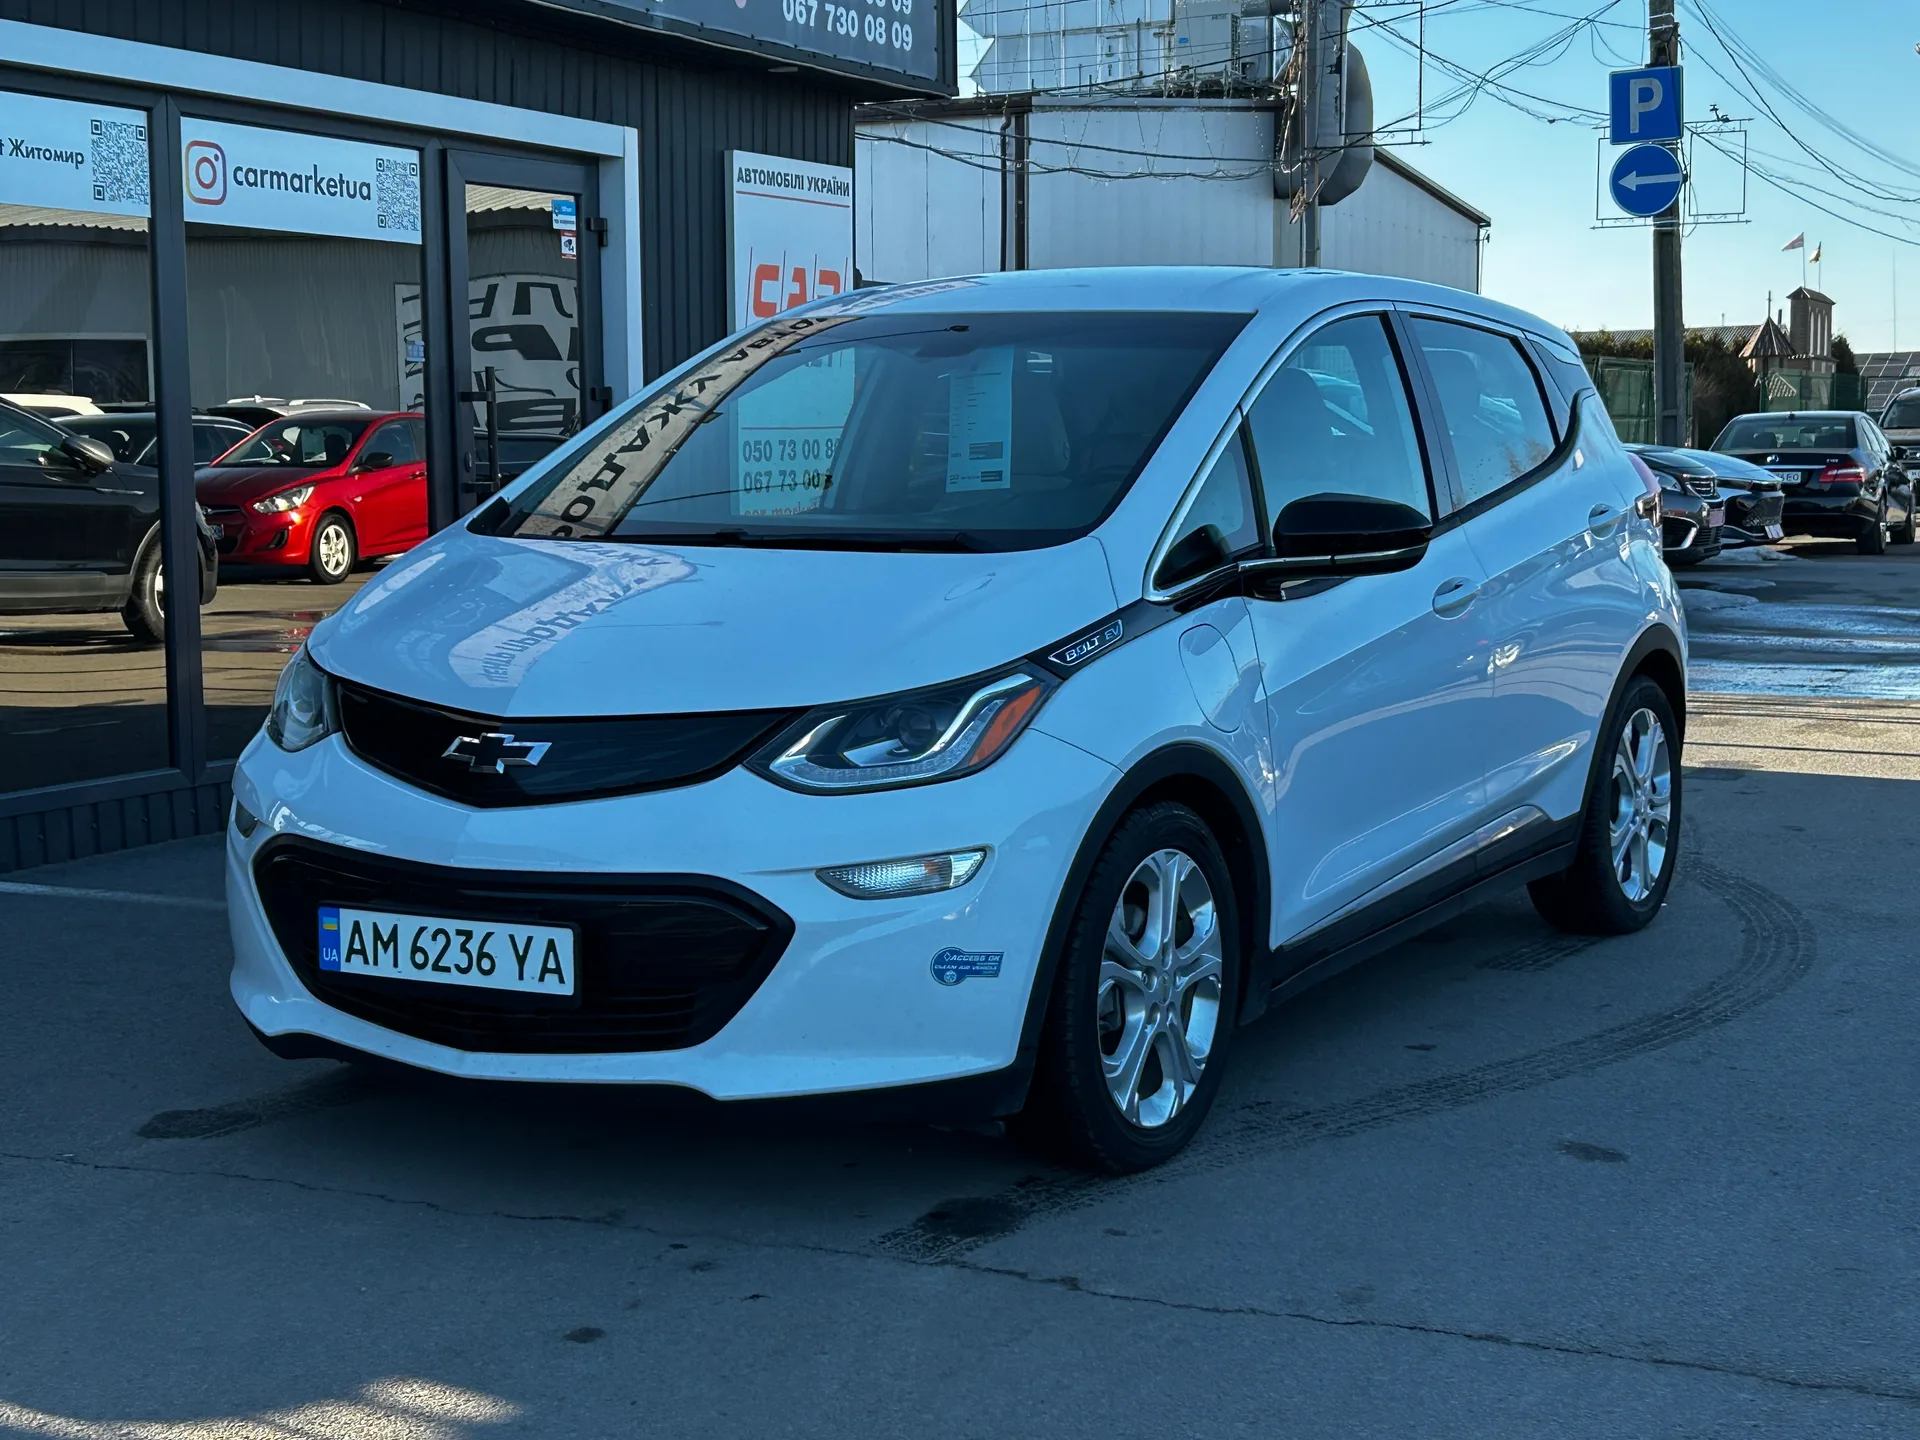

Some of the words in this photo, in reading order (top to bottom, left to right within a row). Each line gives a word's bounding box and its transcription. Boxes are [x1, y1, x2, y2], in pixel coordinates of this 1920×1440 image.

[783, 0, 818, 27] 067
[825, 3, 859, 38] 730
[864, 13, 887, 45] 08
[892, 21, 913, 51] 09
[1629, 78, 1663, 134] P
[8, 137, 85, 170] Житомир
[233, 163, 372, 201] carmarketua
[737, 166, 804, 191] АВТОМОБІЛІ
[807, 175, 850, 197] УКРАЇНИ
[742, 439, 773, 463] 050
[778, 438, 797, 462] 73
[802, 438, 820, 461] 00
[743, 470, 773, 494] 067
[778, 469, 797, 492] 73
[1064, 634, 1100, 662] BOLT
[1104, 625, 1119, 641] EV
[322, 947, 339, 963] UA
[345, 919, 399, 969] AM
[410, 926, 496, 977] 6236
[508, 933, 566, 985] YA
